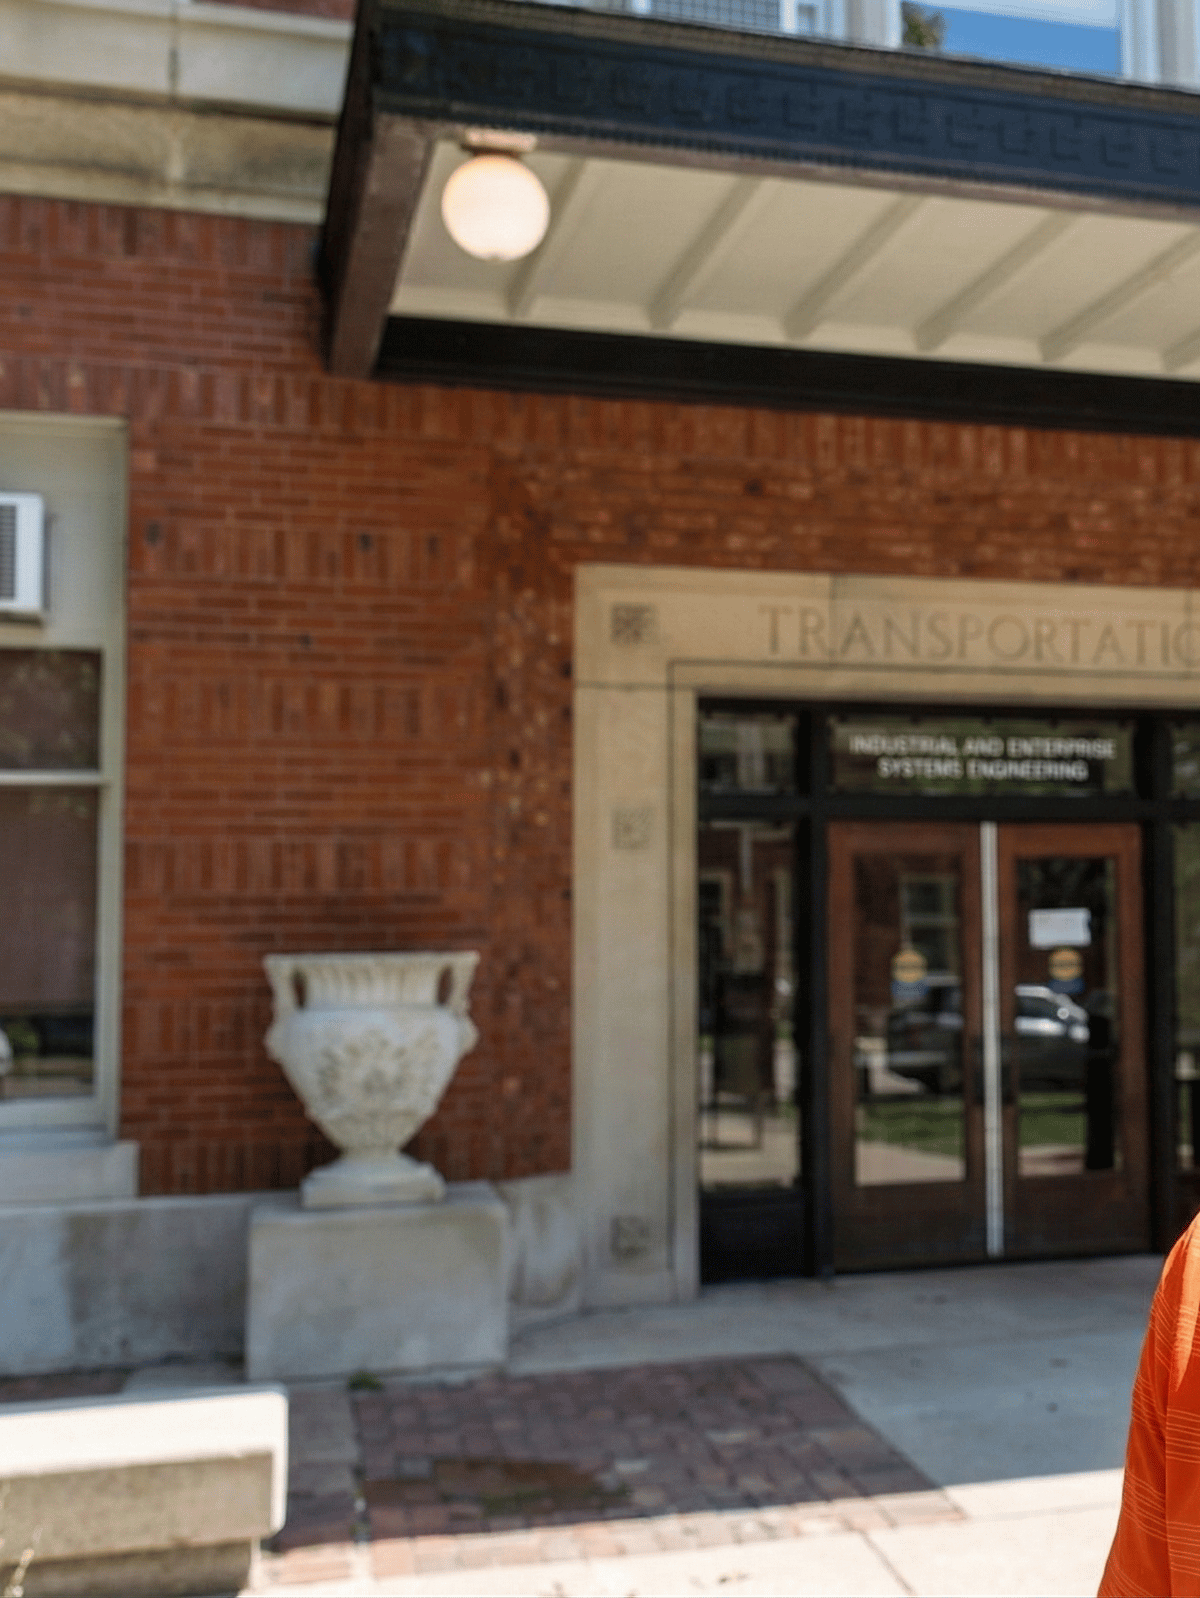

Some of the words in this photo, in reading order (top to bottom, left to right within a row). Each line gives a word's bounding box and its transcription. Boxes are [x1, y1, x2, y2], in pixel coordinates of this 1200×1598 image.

[853, 734, 958, 756] INDUSTRIAL
[963, 736, 1004, 758] AND
[1006, 737, 1116, 760] ENTERPRISE
[877, 756, 964, 780] SYSTEMS
[966, 759, 1089, 782] ENGINEERING
